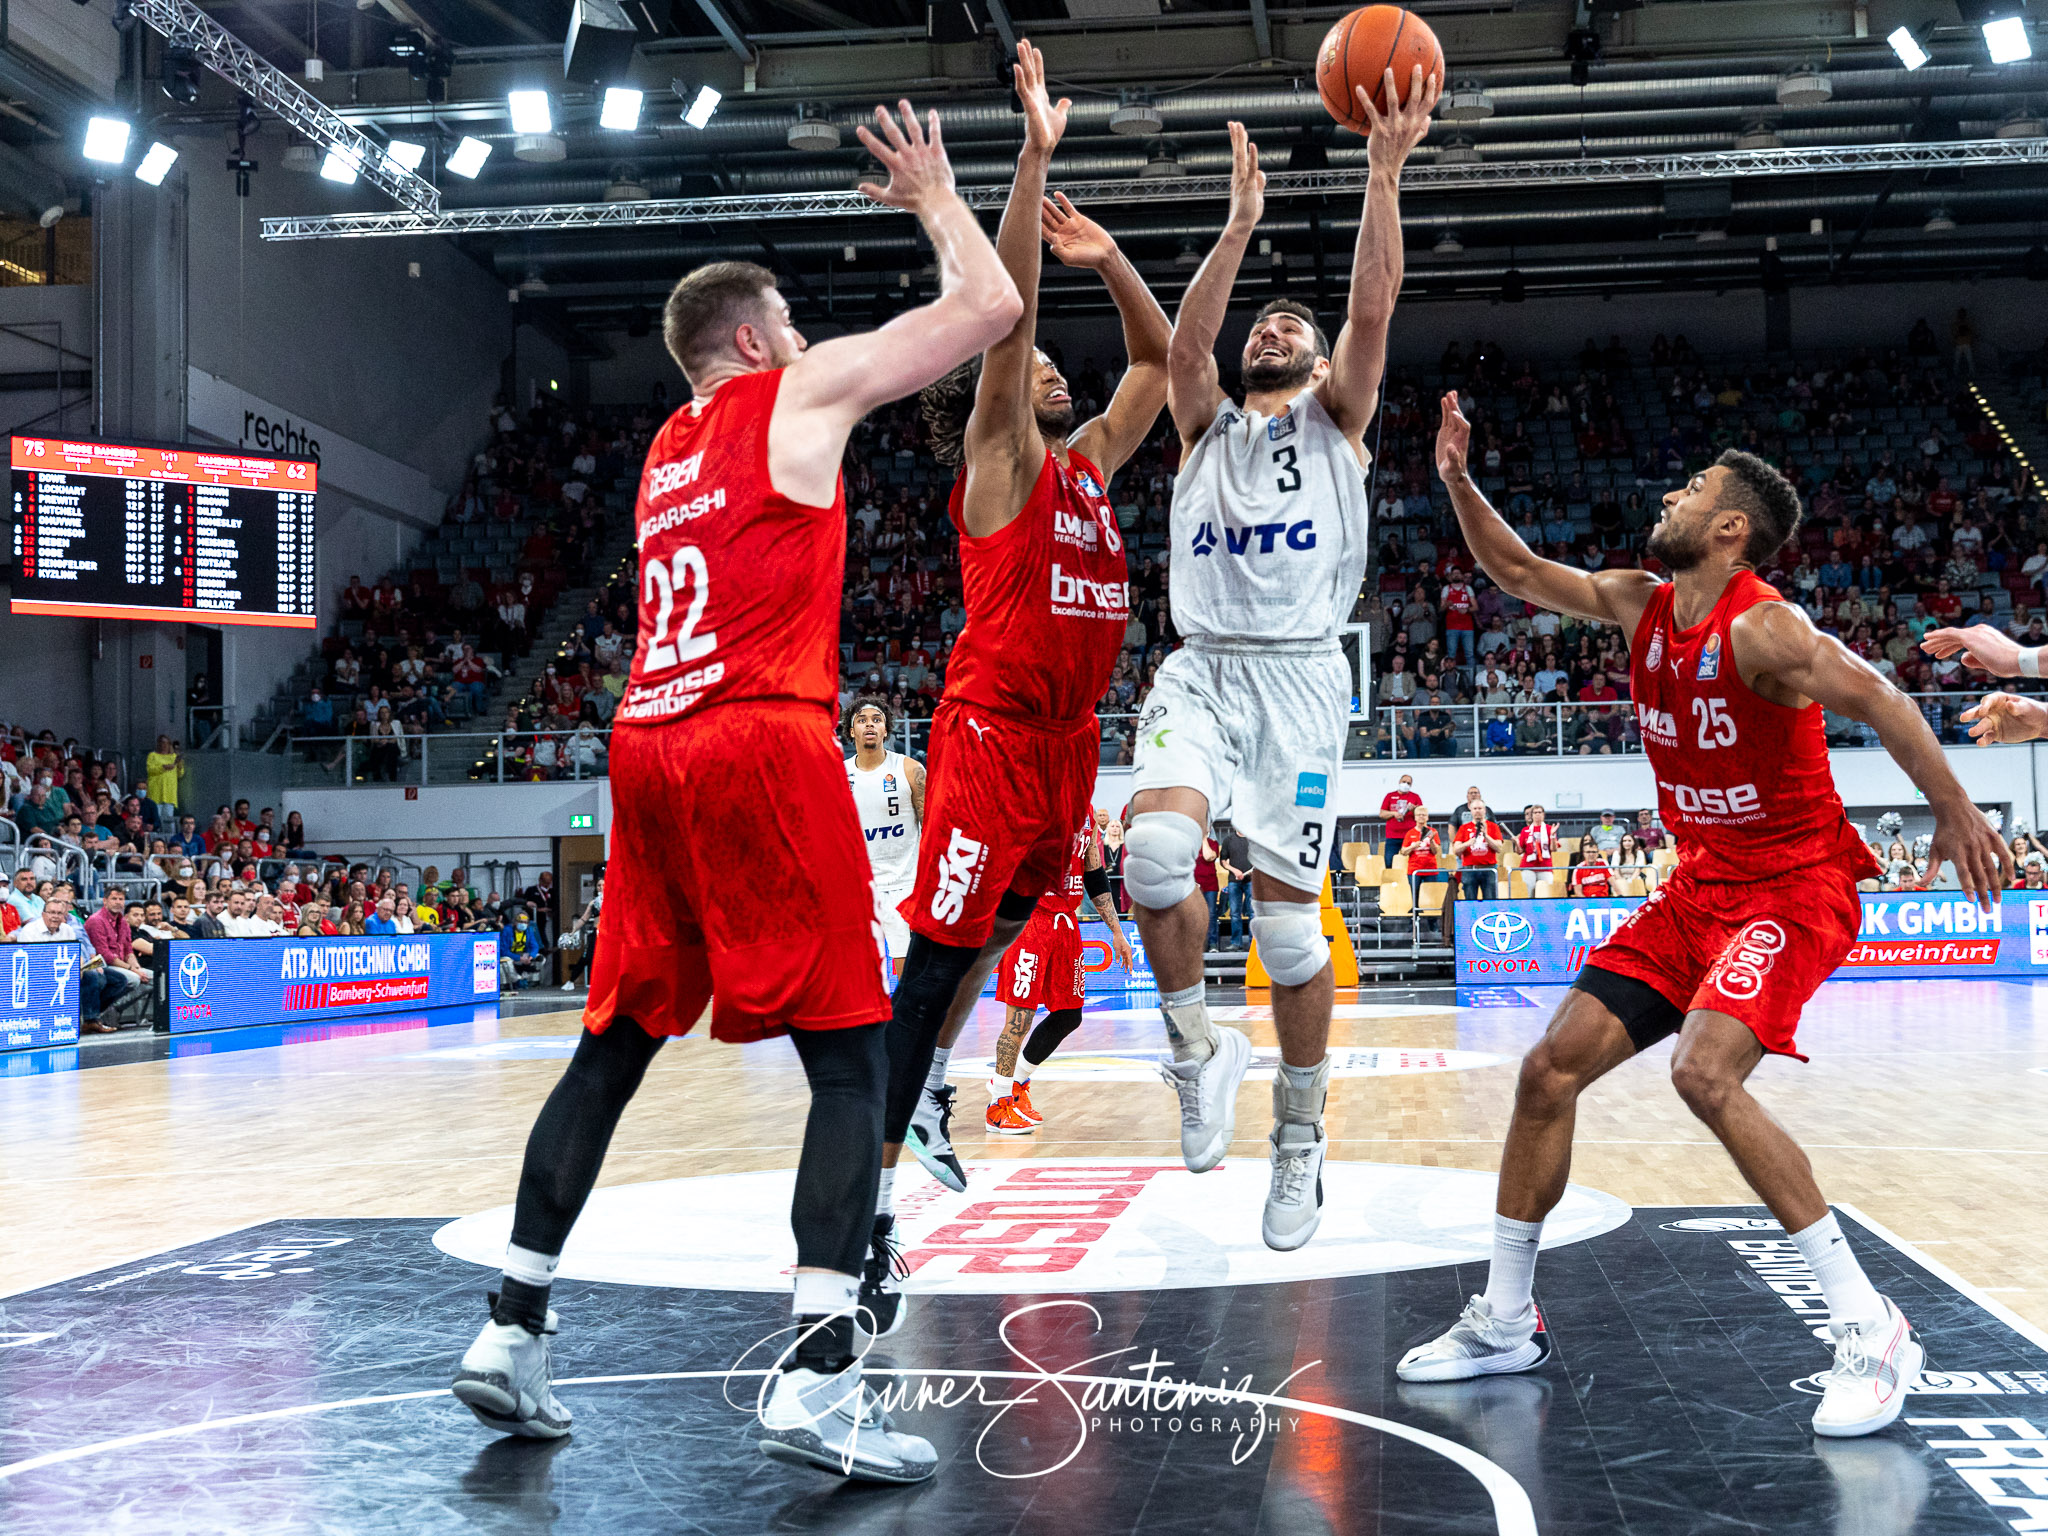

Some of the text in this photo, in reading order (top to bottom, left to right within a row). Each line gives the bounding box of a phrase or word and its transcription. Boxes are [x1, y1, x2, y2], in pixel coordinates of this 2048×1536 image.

[23, 439, 46, 457] 75
[244, 409, 321, 471] rechts
[286, 463, 307, 480] 62
[650, 450, 704, 501] GEBEN
[1272, 445, 1301, 493] 3
[39, 484, 86, 496] LOCKHART
[39, 494, 79, 506] PREWITT
[39, 505, 84, 517] MITCHELL
[1098, 505, 1122, 552] 8
[1224, 519, 1317, 556] VTG
[643, 546, 717, 673] 22
[1051, 604, 1096, 618] Excellence
[1692, 697, 1738, 750] 25
[887, 796, 899, 817] 5
[1694, 811, 1767, 825] Mechatronics
[864, 823, 905, 842] VTG
[1299, 822, 1323, 870] 3
[931, 827, 982, 926] SIXT
[970, 873, 982, 894] rent
[980, 844, 990, 862] car
[1897, 901, 2003, 935] GMBH
[281, 943, 431, 979] ATB AUTOTECHNIK GMBH
[1013, 948, 1036, 999] SIXT
[1072, 958, 1080, 996] AUTOMATION
[1466, 958, 1542, 974] TOYOTA
[329, 981, 429, 1003] Bamberg-Schweinfurt
[176, 1004, 213, 1021] TOYOTA
